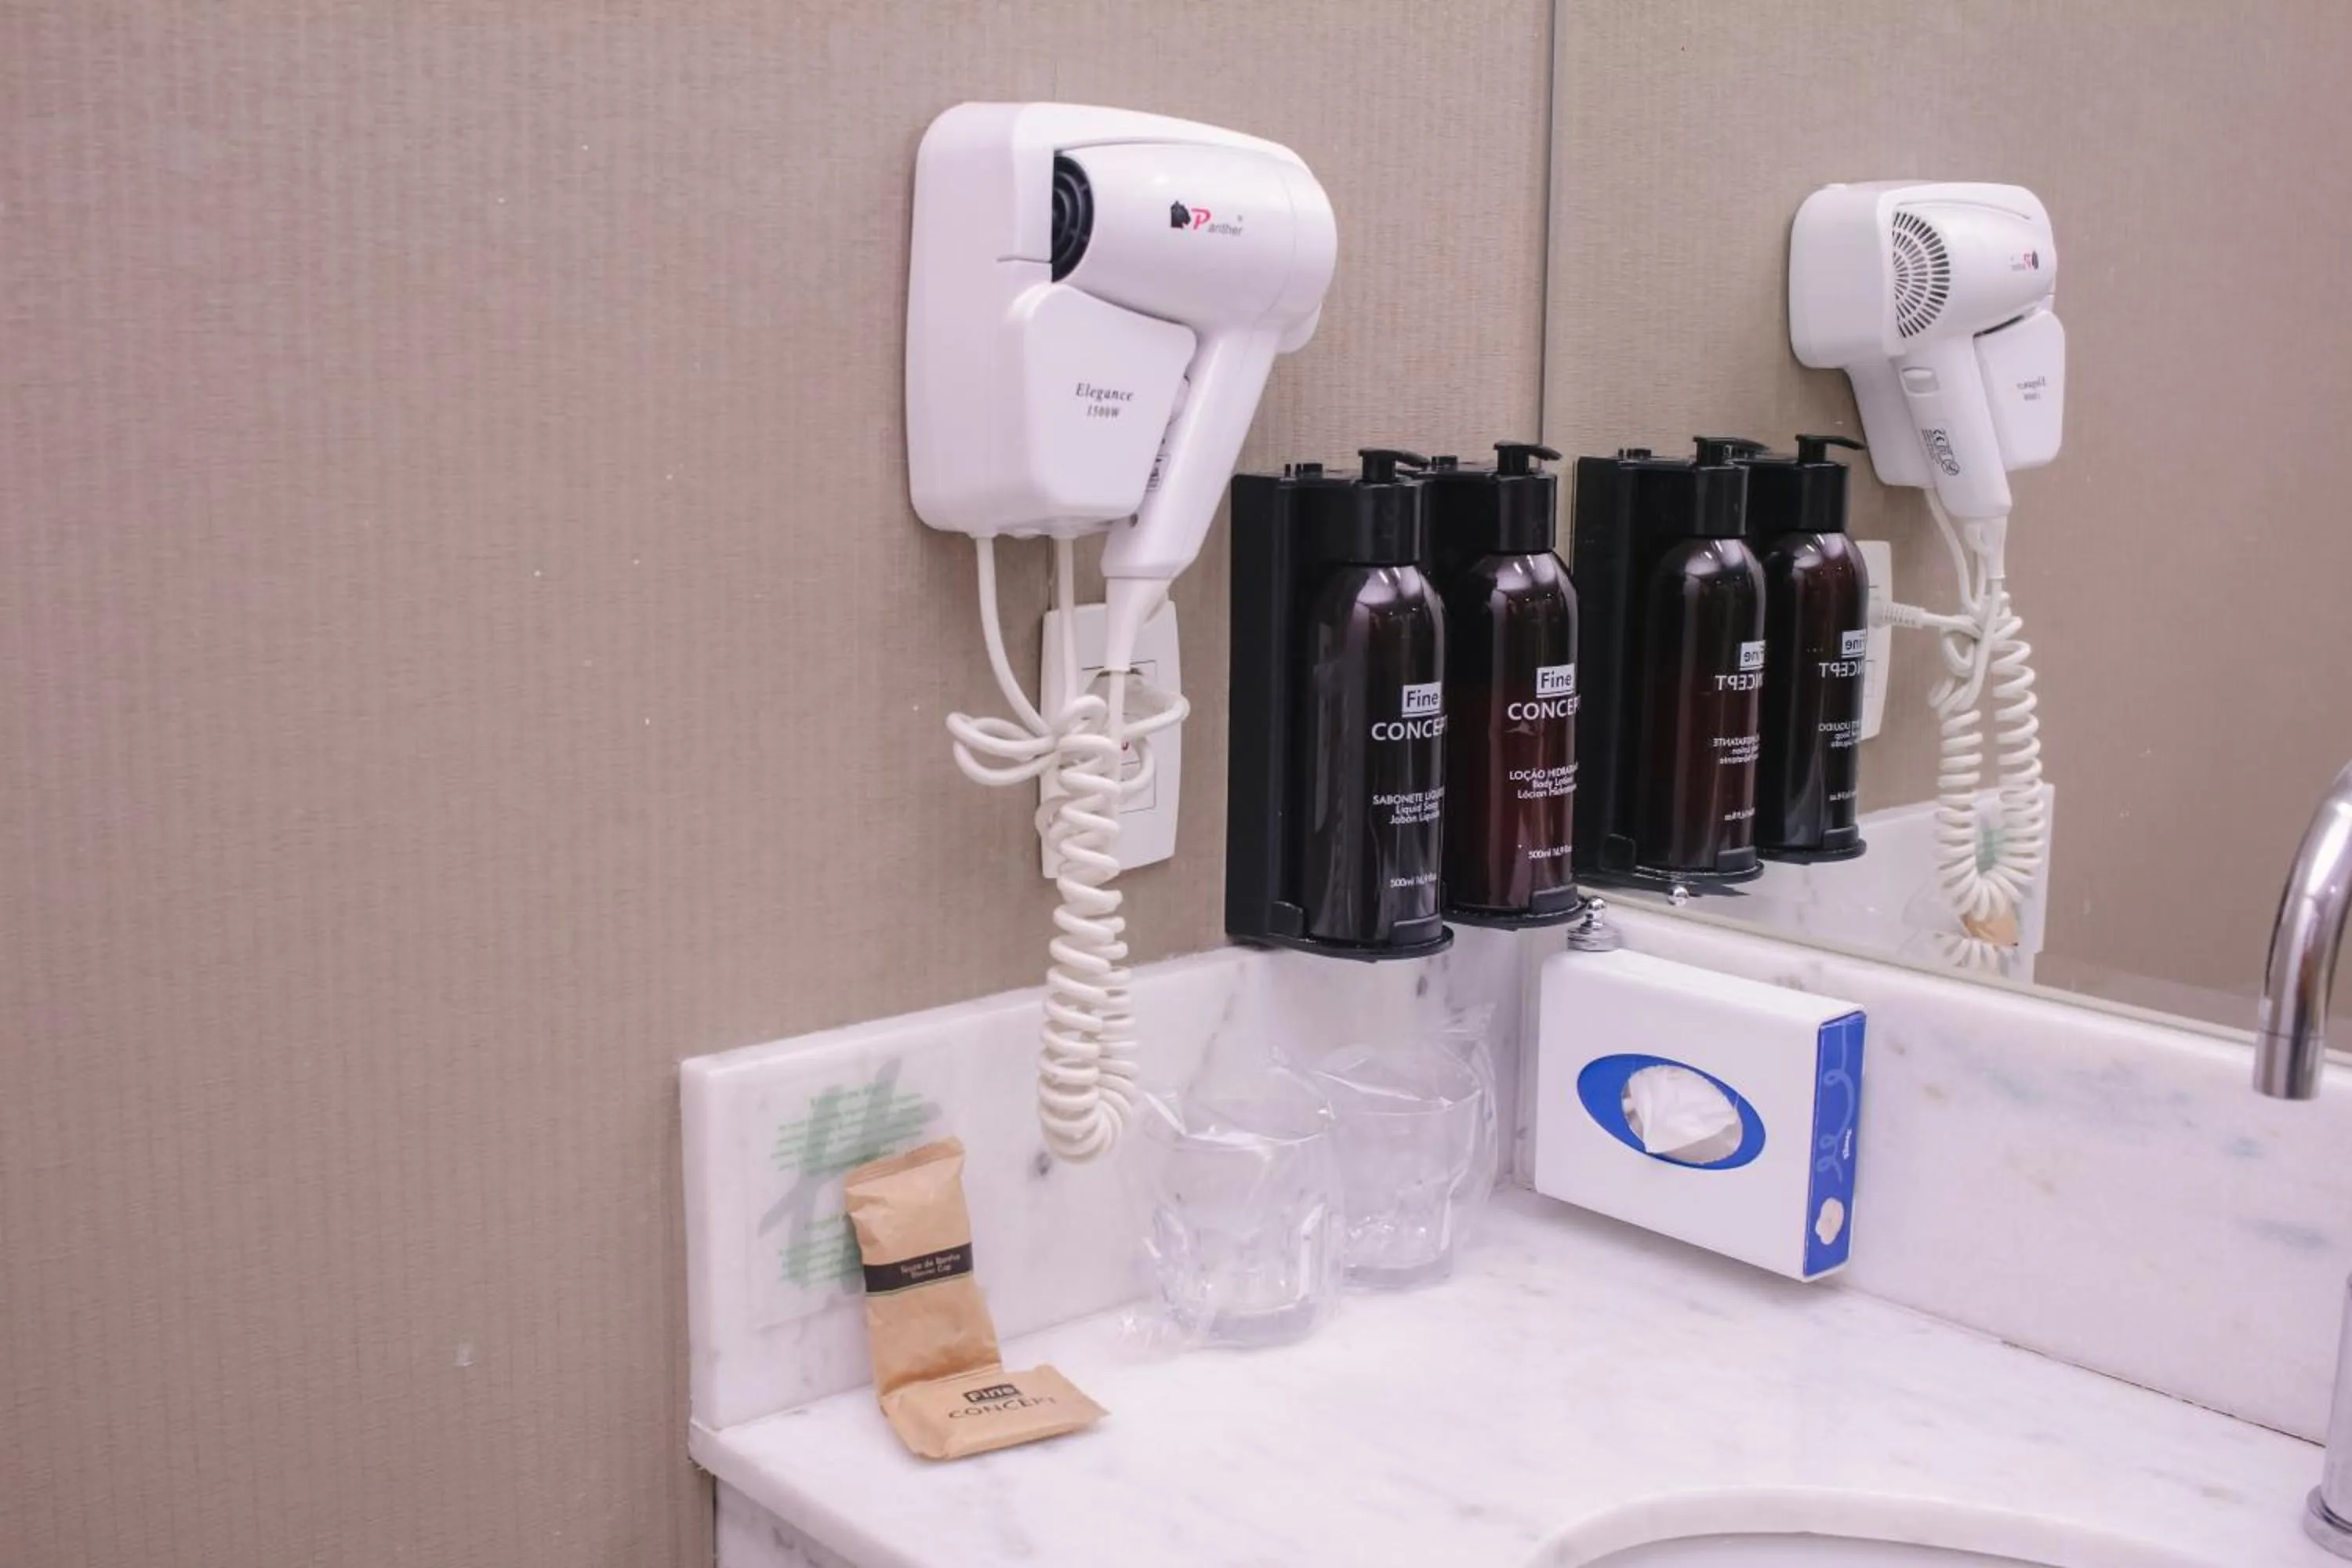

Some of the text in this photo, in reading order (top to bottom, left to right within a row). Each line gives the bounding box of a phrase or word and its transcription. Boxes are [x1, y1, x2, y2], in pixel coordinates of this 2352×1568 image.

[1076, 382, 1134, 402] Elegance
[1087, 404, 1120, 419] 1500W
[1541, 670, 1572, 689] Fine
[1406, 689, 1439, 708] Fine
[1508, 695, 1581, 720] CONCEP
[1373, 792, 1424, 806] SABONETE
